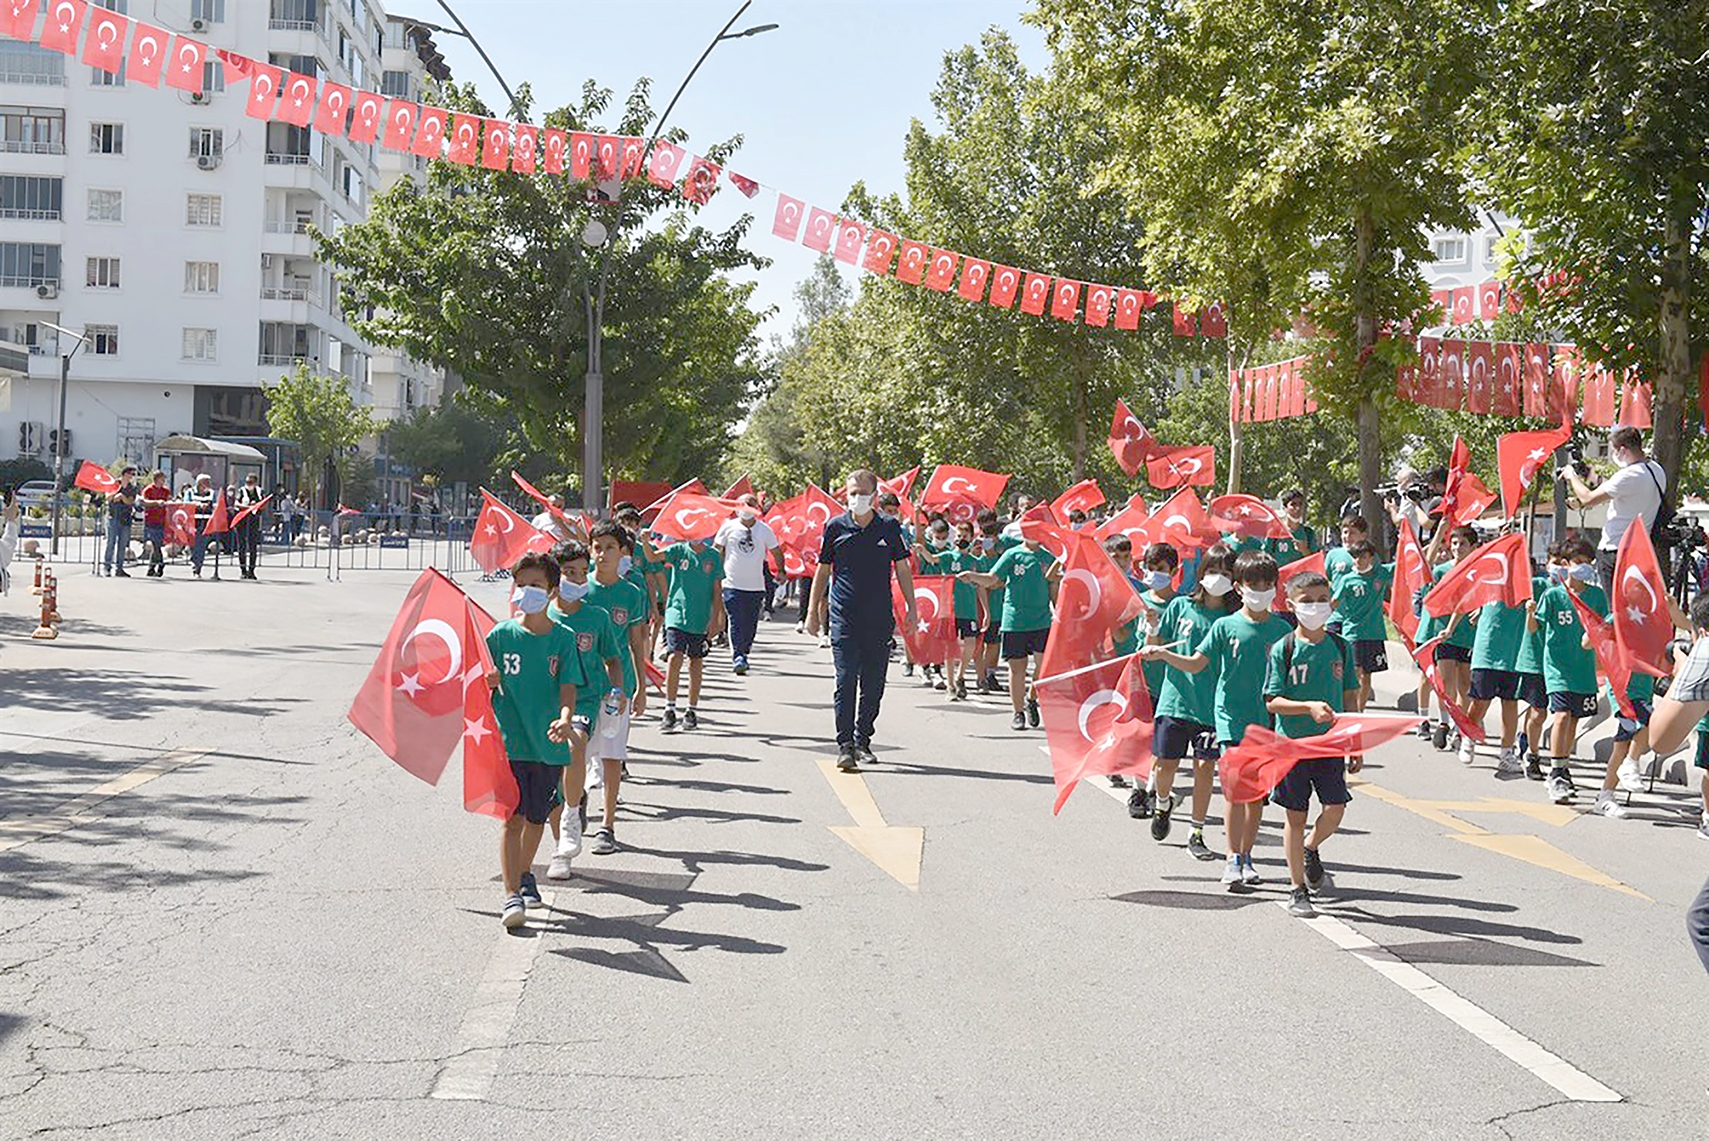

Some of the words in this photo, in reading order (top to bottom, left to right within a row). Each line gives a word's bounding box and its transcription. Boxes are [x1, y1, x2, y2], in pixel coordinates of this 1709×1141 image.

[1558, 611, 1573, 626] 55
[503, 653, 520, 675] 53
[1289, 664, 1308, 686] 17
[1583, 696, 1596, 711] 55
